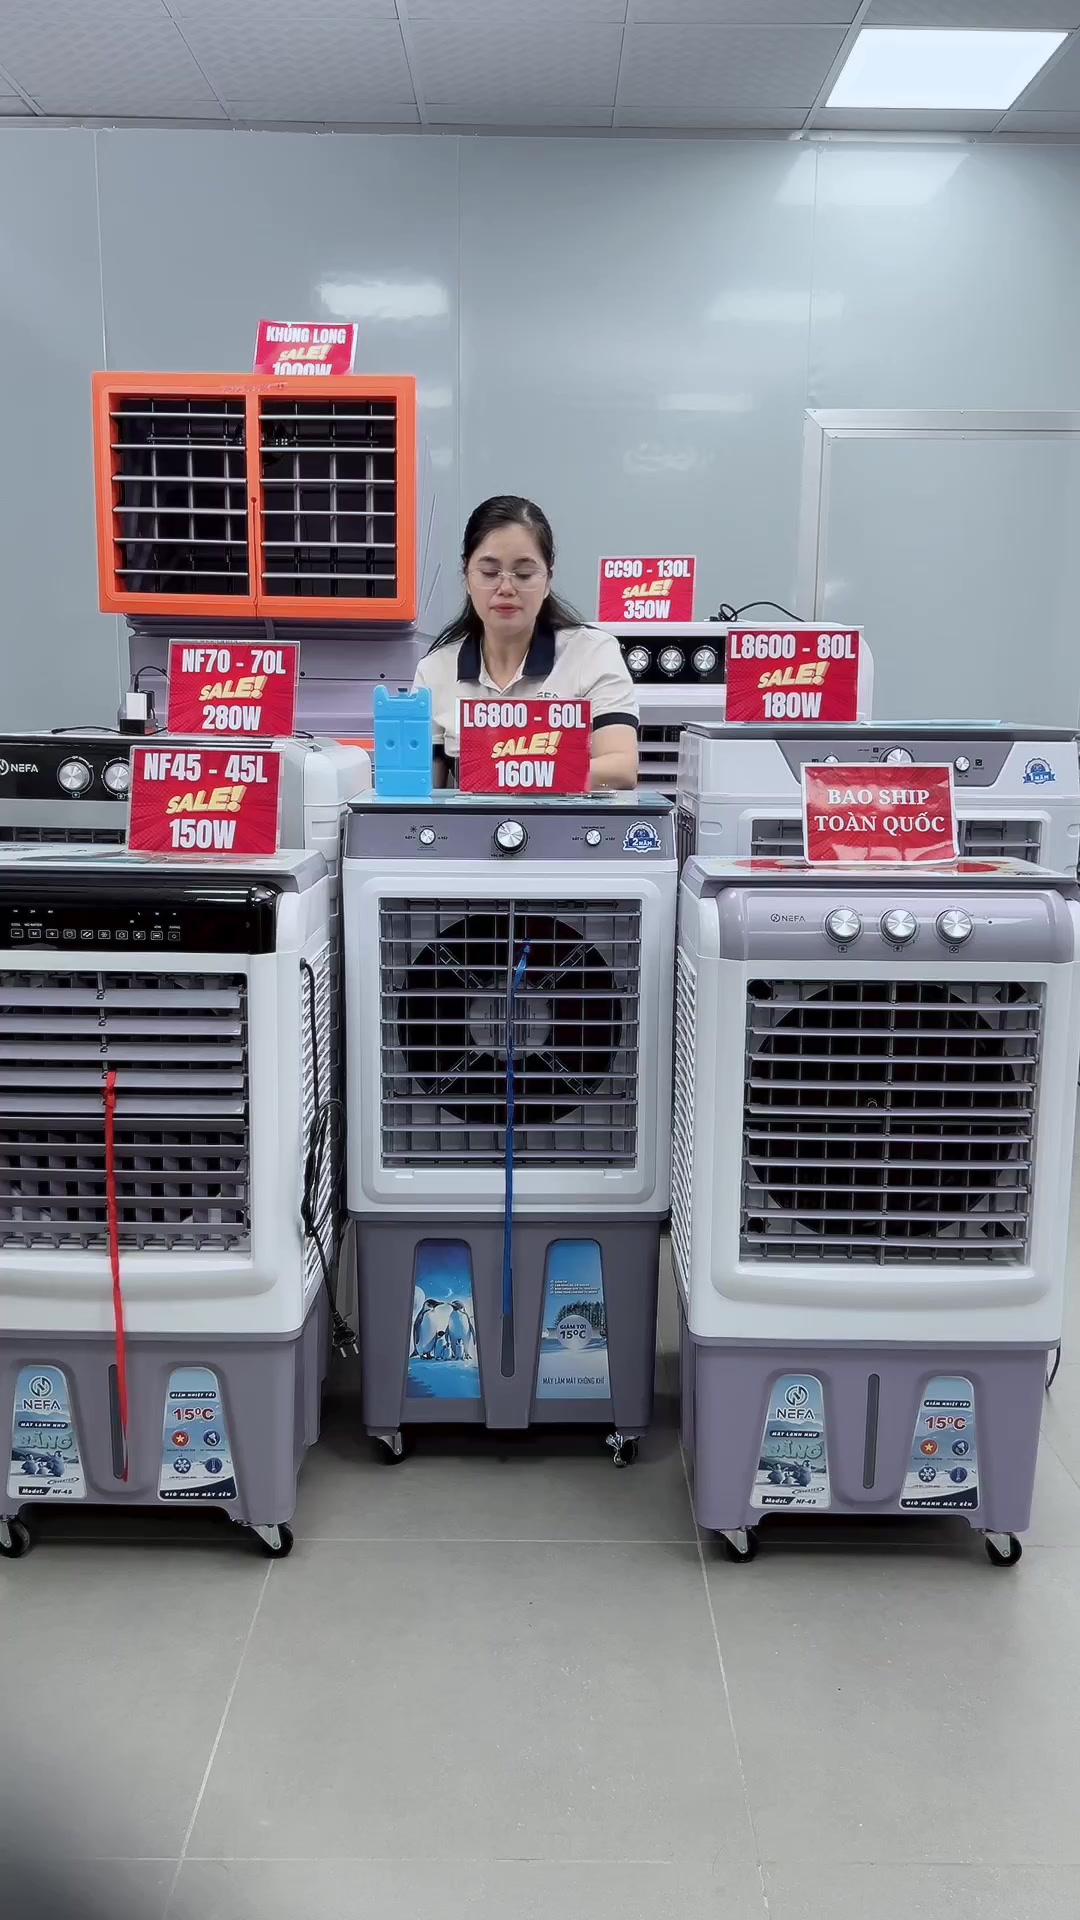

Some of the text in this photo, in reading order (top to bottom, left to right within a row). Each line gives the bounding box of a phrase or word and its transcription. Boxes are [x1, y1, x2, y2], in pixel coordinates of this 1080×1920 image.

[266, 323, 347, 344] KHỦNG LONG
[278, 344, 332, 361] SALE!
[272, 362, 332, 376] 1000W
[604, 560, 643, 578] CC90
[657, 559, 691, 578] 130L
[621, 579, 673, 599] SALE!
[623, 599, 671, 619] 350W
[730, 634, 796, 659] L8600
[817, 634, 856, 659] 80L
[182, 649, 231, 673] NF70
[250, 649, 286, 675] 70L
[757, 661, 830, 689] SALE!
[198, 675, 268, 701] SALE!
[463, 703, 528, 728] L6800
[548, 703, 586, 728] 60L
[762, 692, 823, 718] 180W
[202, 705, 261, 731] 280W
[491, 731, 562, 759] SALE!
[10, 763, 39, 773] NEFA
[144, 753, 201, 782] NF45
[224, 755, 268, 783] 45L
[495, 761, 555, 787] 160W
[166, 785, 247, 815] SALE!
[827, 789, 930, 806] BAO SHIP
[169, 819, 237, 849] 150W
[814, 811, 945, 837] TOÀN QUỐC
[23, 1399, 61, 1410] NEFA
[776, 1408, 815, 1420] NEFA
